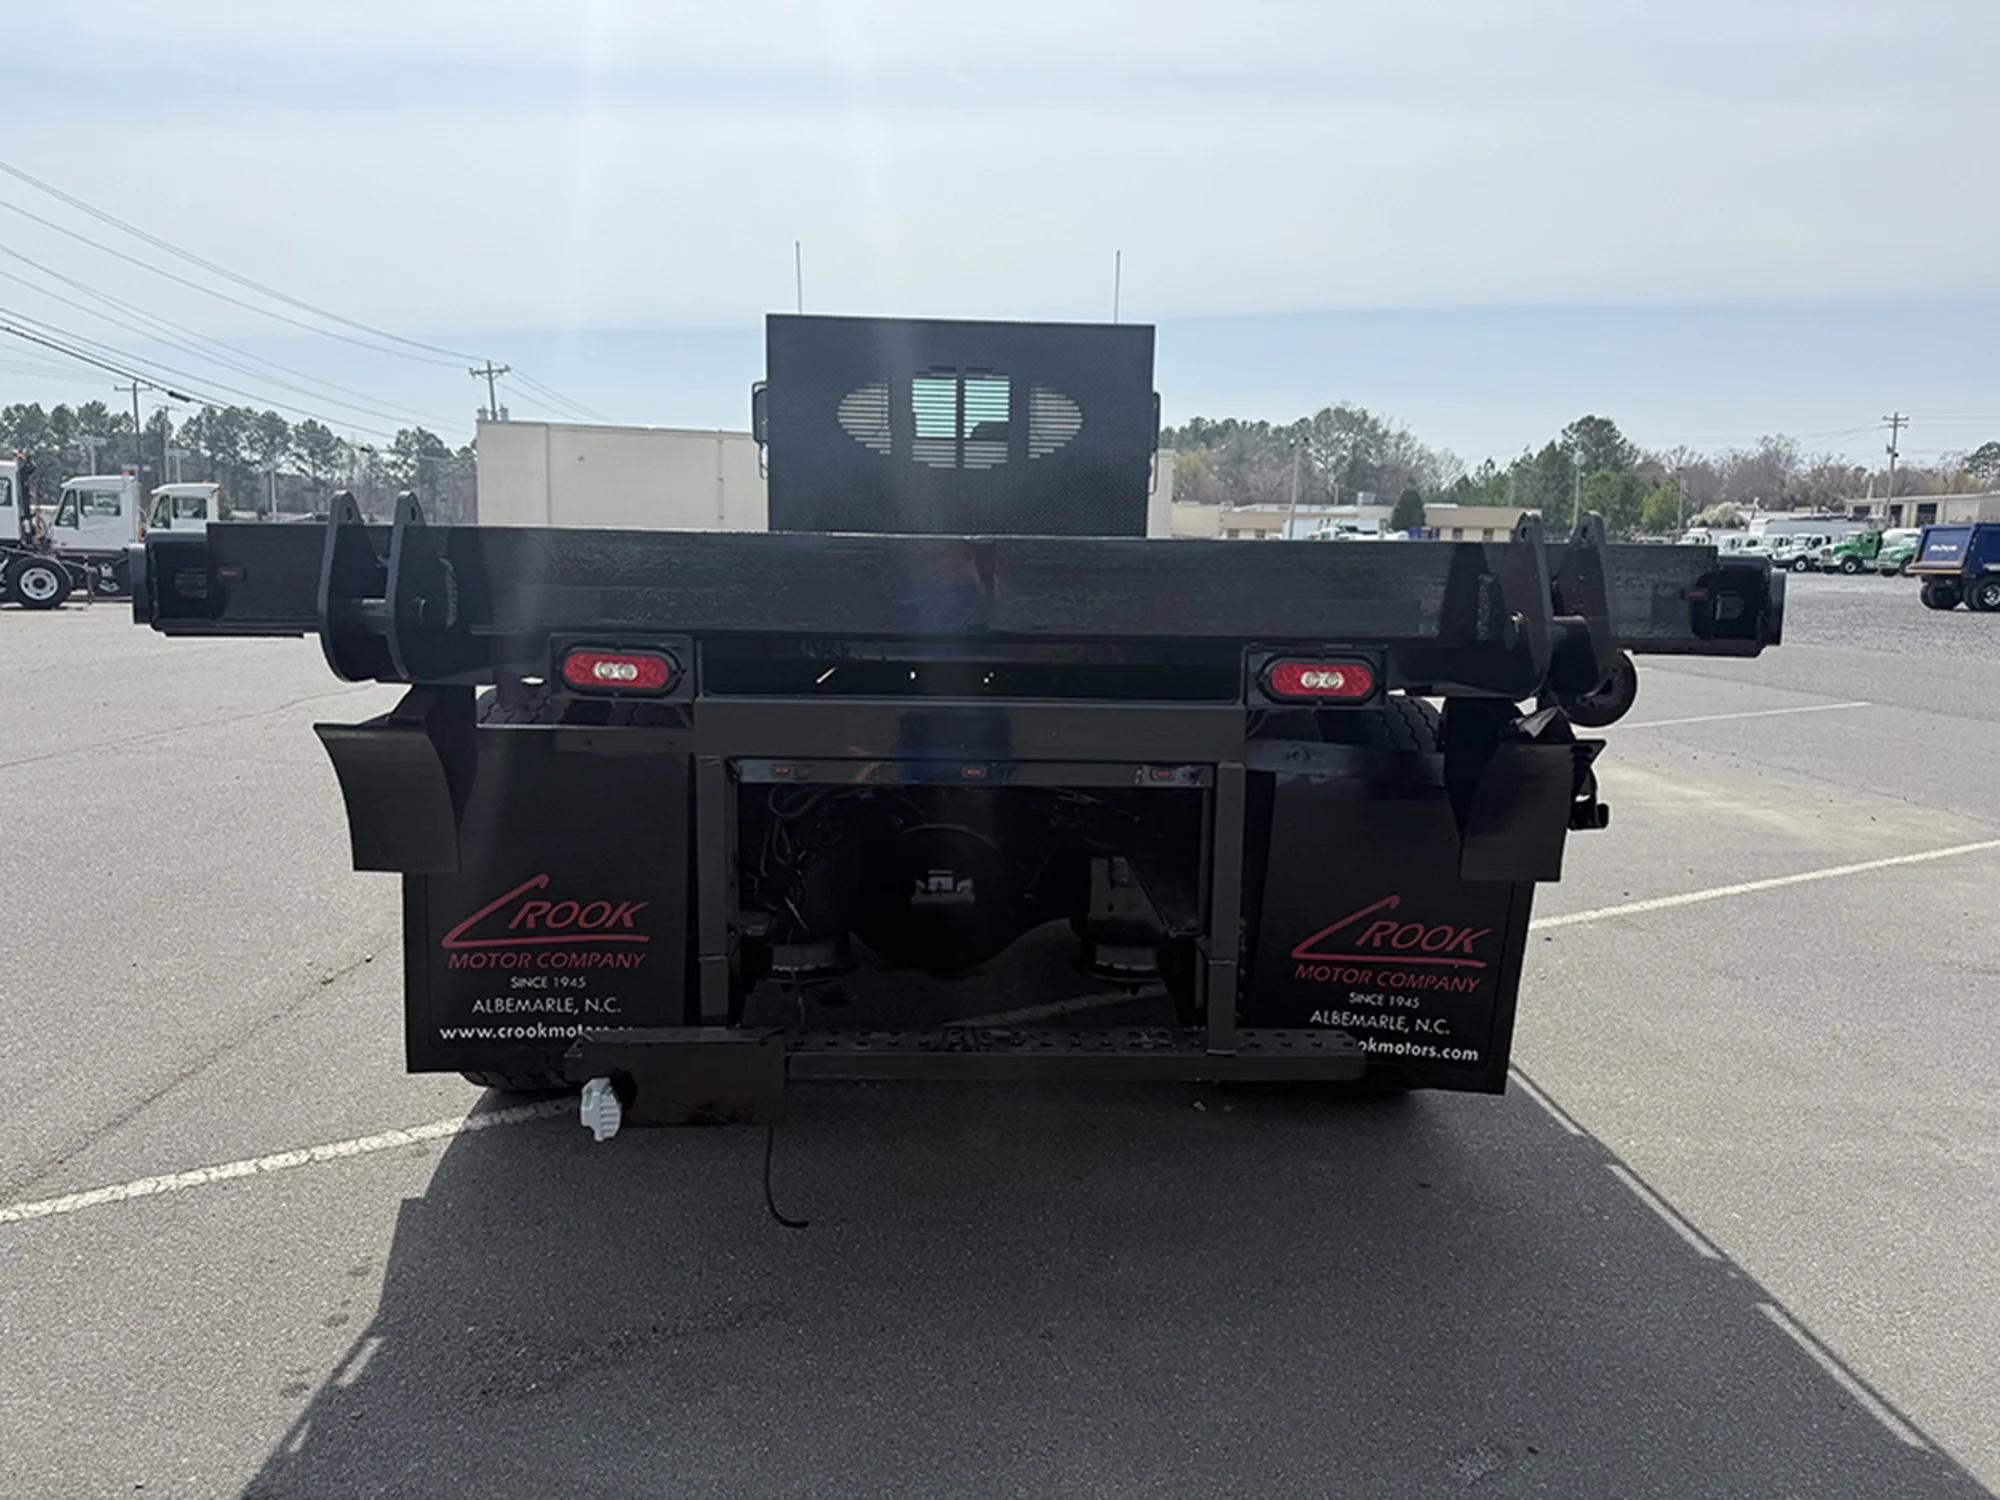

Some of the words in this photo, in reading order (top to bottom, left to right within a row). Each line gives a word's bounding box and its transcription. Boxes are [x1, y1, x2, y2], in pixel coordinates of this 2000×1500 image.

[448, 953, 531, 969] MOTOR
[536, 953, 645, 969] COMPANY
[510, 976, 548, 989] SINCE
[1295, 964, 1371, 985] MOTOR
[1376, 972, 1480, 993] COMPANY
[471, 997, 580, 1015] ALBEMARLE,
[584, 997, 622, 1014] N.C.
[1349, 991, 1384, 1006] SINCE
[439, 1021, 634, 1040] www.crookmot
[1309, 1010, 1411, 1034] ALBEMARLE,
[1415, 1018, 1451, 1035] N.C.
